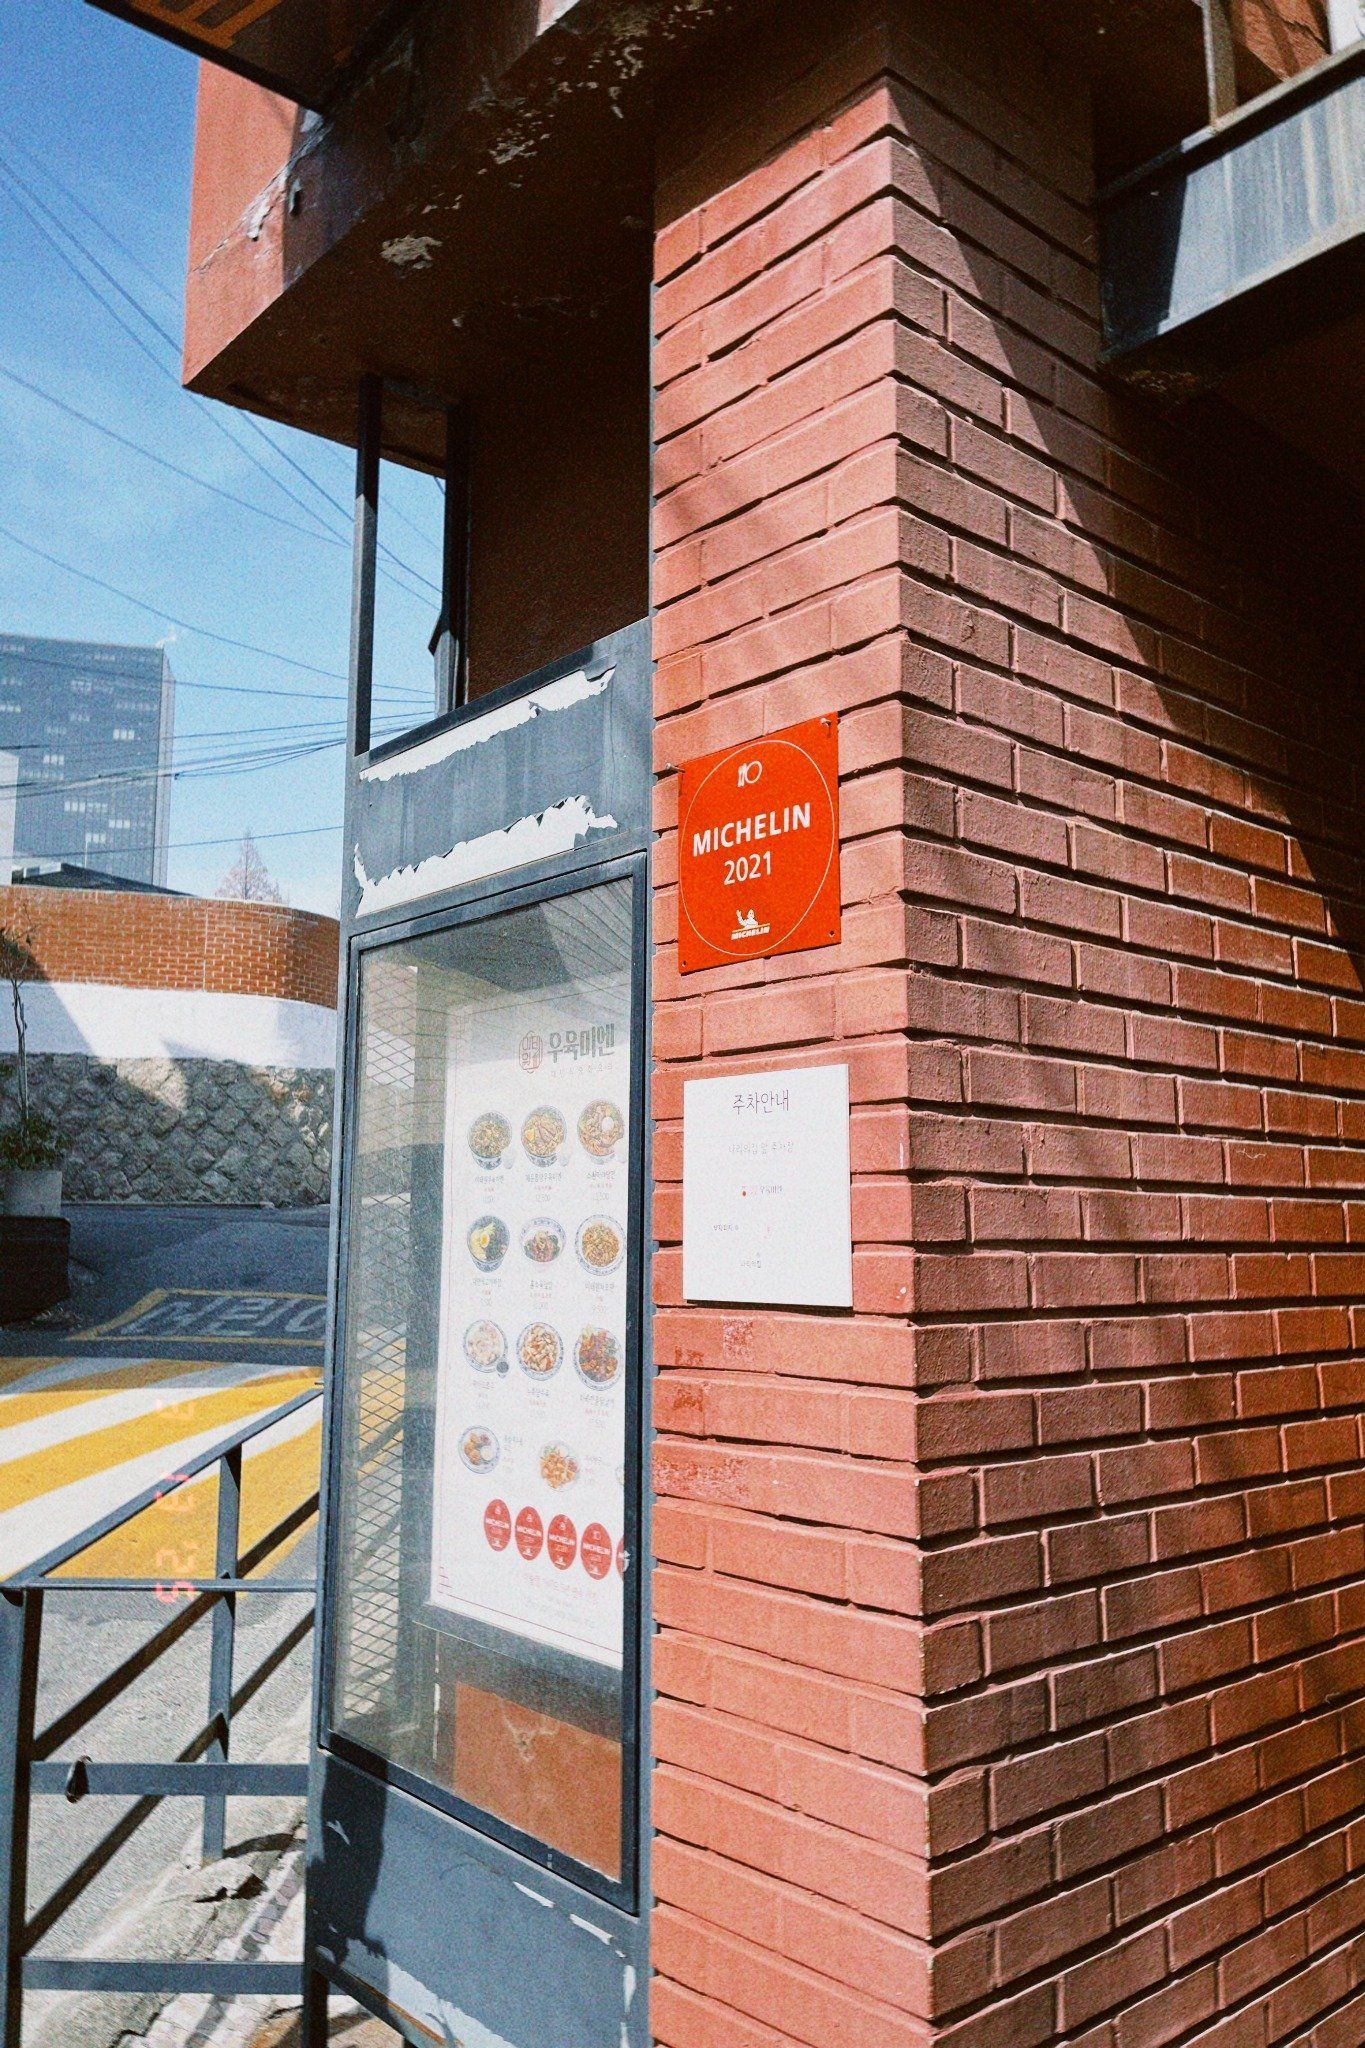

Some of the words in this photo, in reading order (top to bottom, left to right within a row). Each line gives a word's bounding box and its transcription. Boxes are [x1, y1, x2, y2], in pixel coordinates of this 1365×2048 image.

[693, 802, 811, 857] MICHELIN
[724, 850, 771, 885] 2021
[731, 925, 770, 940] MICHELIN
[547, 1023, 615, 1063] 우육미엔
[733, 1089, 789, 1115] 주차안내
